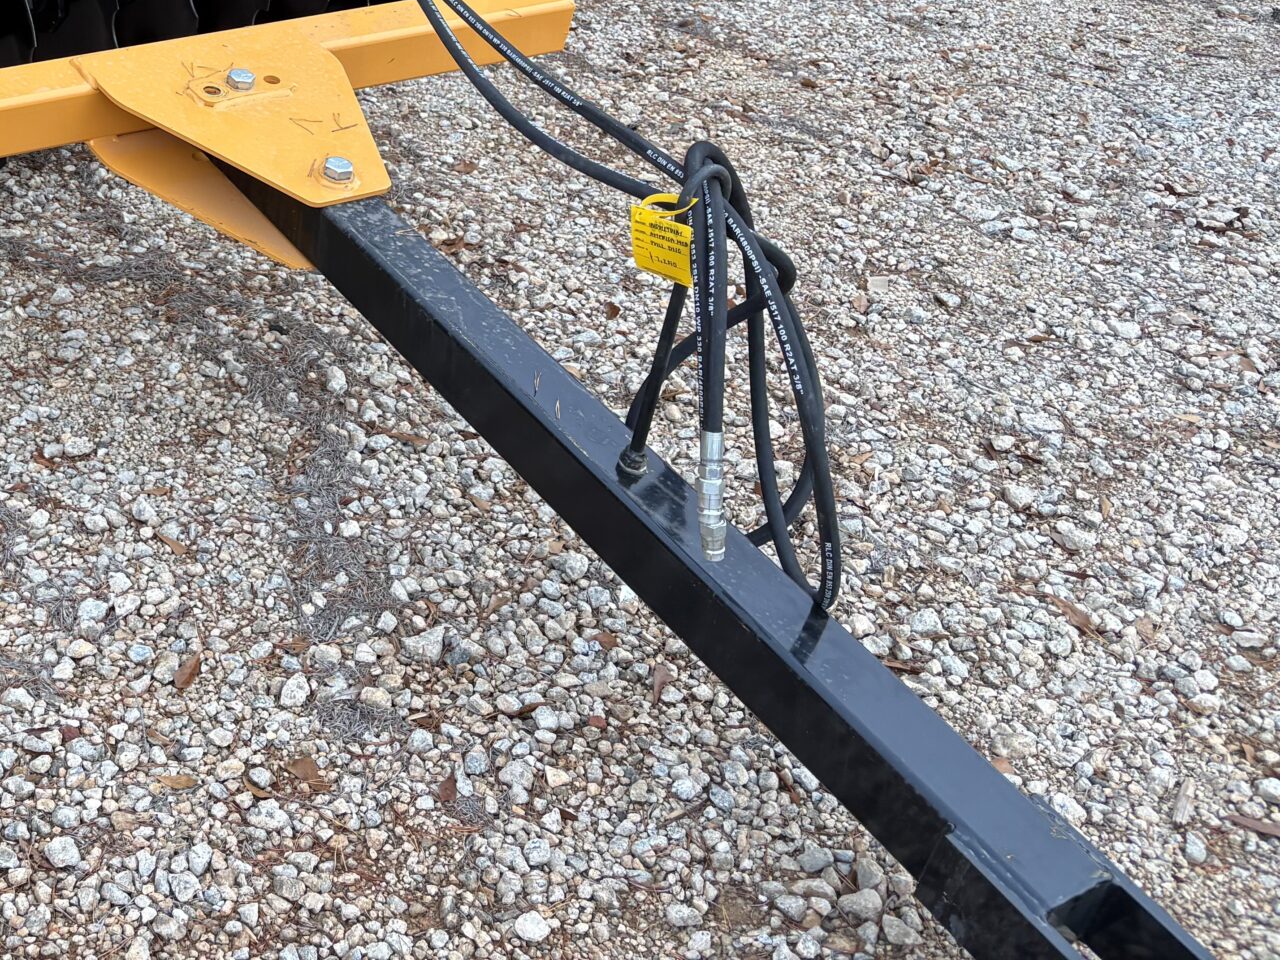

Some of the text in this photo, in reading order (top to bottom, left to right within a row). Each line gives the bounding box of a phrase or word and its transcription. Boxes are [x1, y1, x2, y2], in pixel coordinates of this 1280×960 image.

[728, 218, 762, 273] BAR(4800PSI)
[759, 275, 772, 297] -SAE
[768, 300, 781, 321] J517
[784, 343, 798, 371] R2AT
